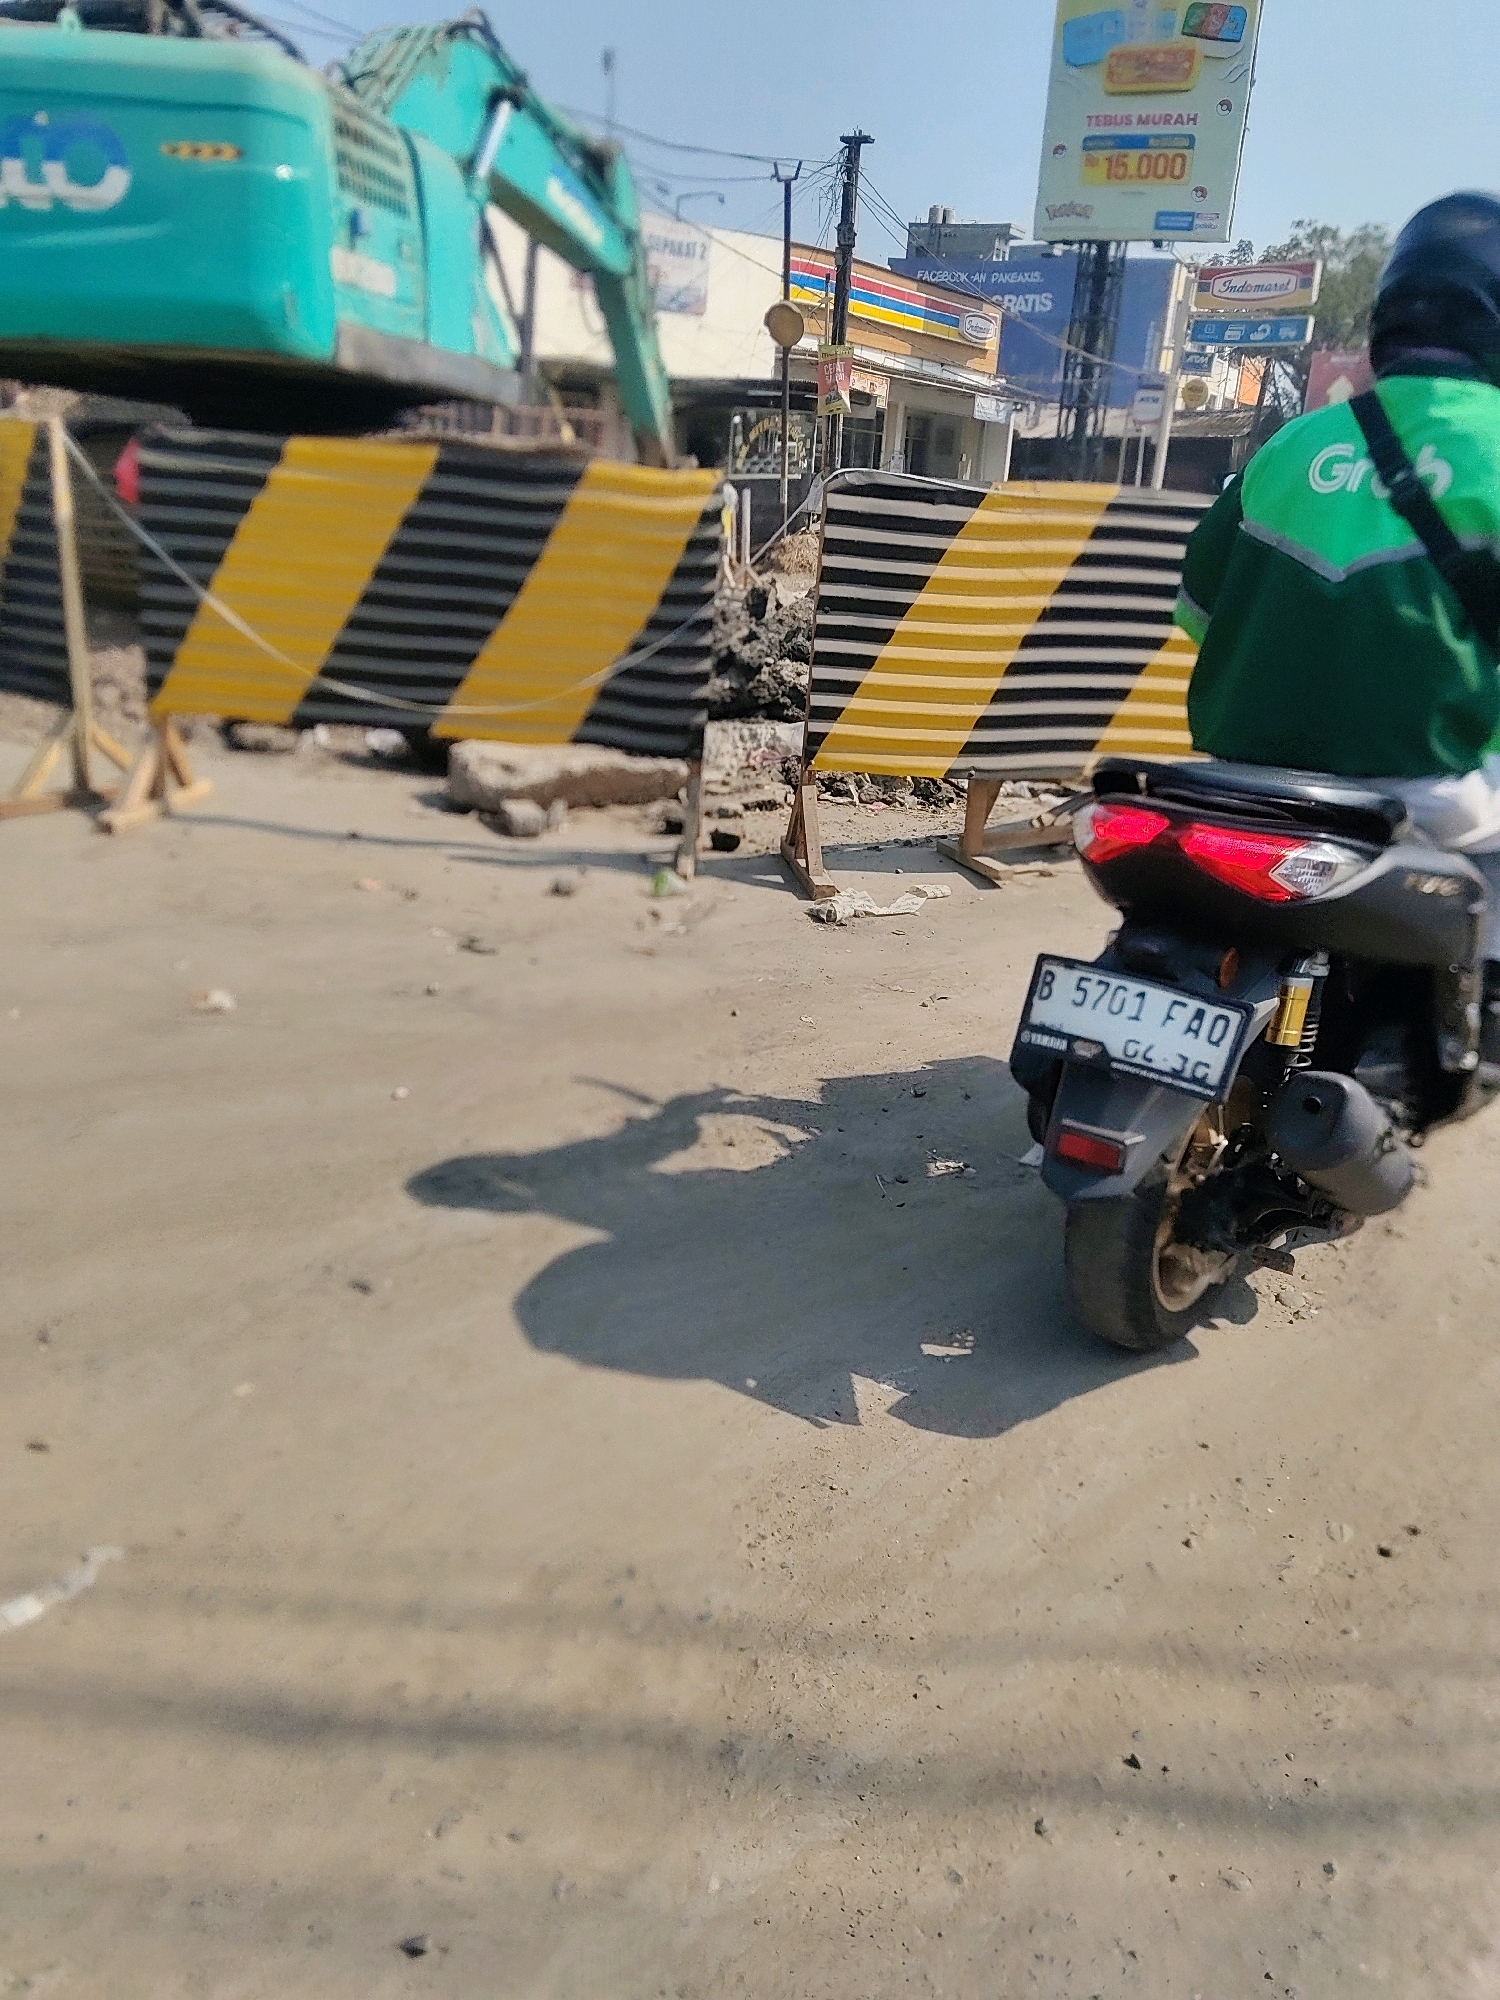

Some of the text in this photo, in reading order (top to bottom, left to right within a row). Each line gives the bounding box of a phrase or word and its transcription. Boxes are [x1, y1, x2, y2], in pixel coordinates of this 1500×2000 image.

[1087, 112, 1198, 127] TEBUS MURAH
[1105, 152, 1187, 181] 15.000
[1217, 278, 1291, 294] Indomaret
[1037, 969, 1231, 1048] B 5701 FAQ
